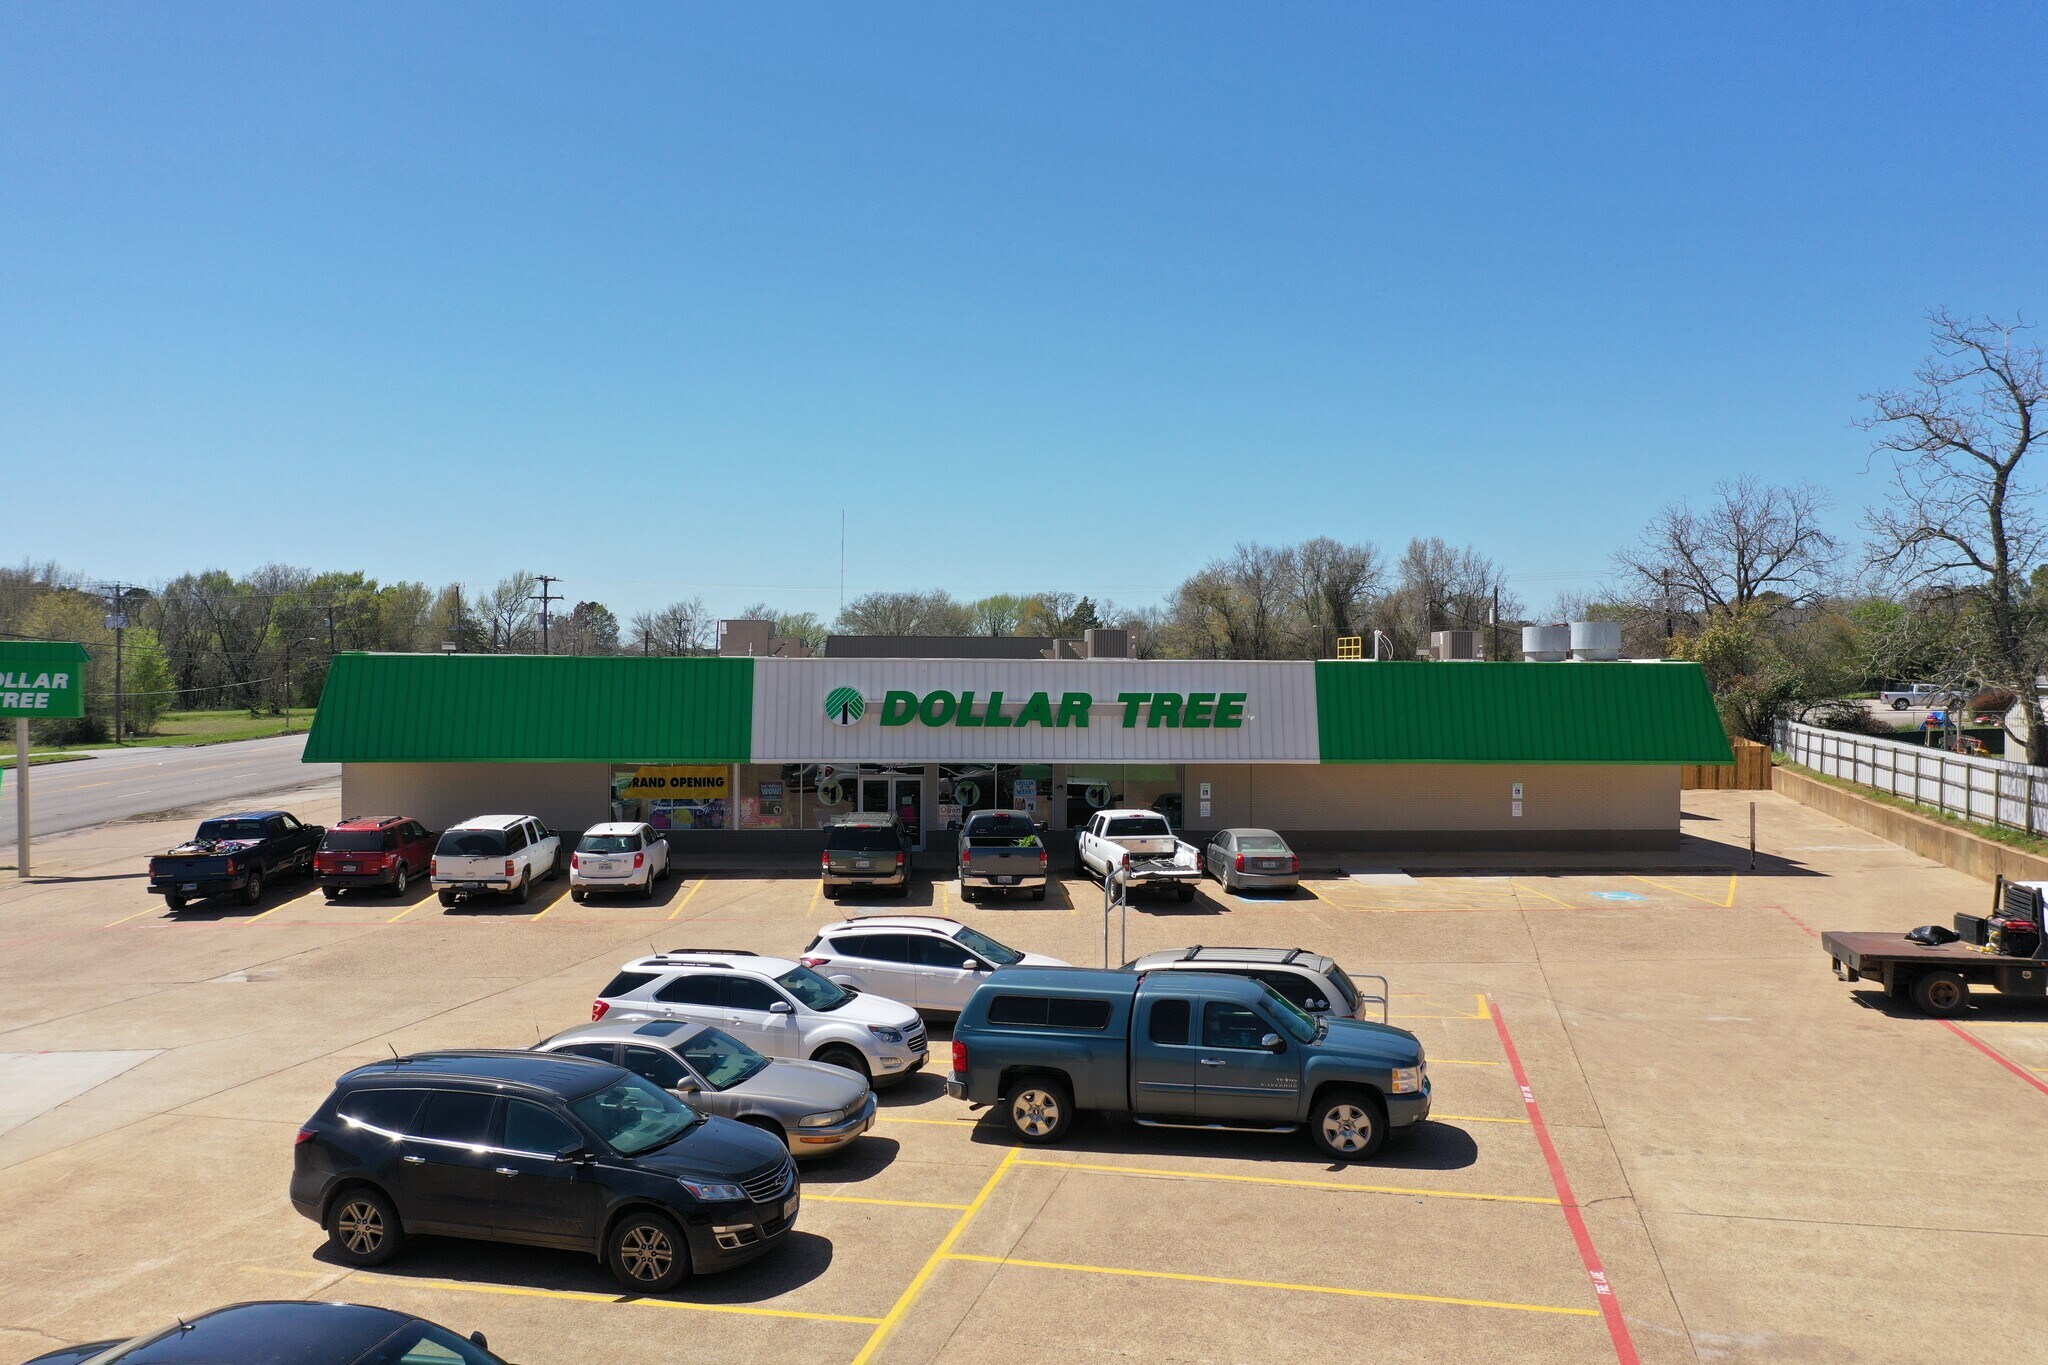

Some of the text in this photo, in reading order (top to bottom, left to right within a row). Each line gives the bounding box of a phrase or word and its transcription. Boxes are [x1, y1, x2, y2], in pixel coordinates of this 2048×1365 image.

[0, 692, 50, 709] REE
[880, 690, 1247, 729] DOLLAR TREE
[628, 777, 725, 788] RAND OPENING
[761, 787, 782, 796] WOW!
[940, 806, 961, 814] Open
